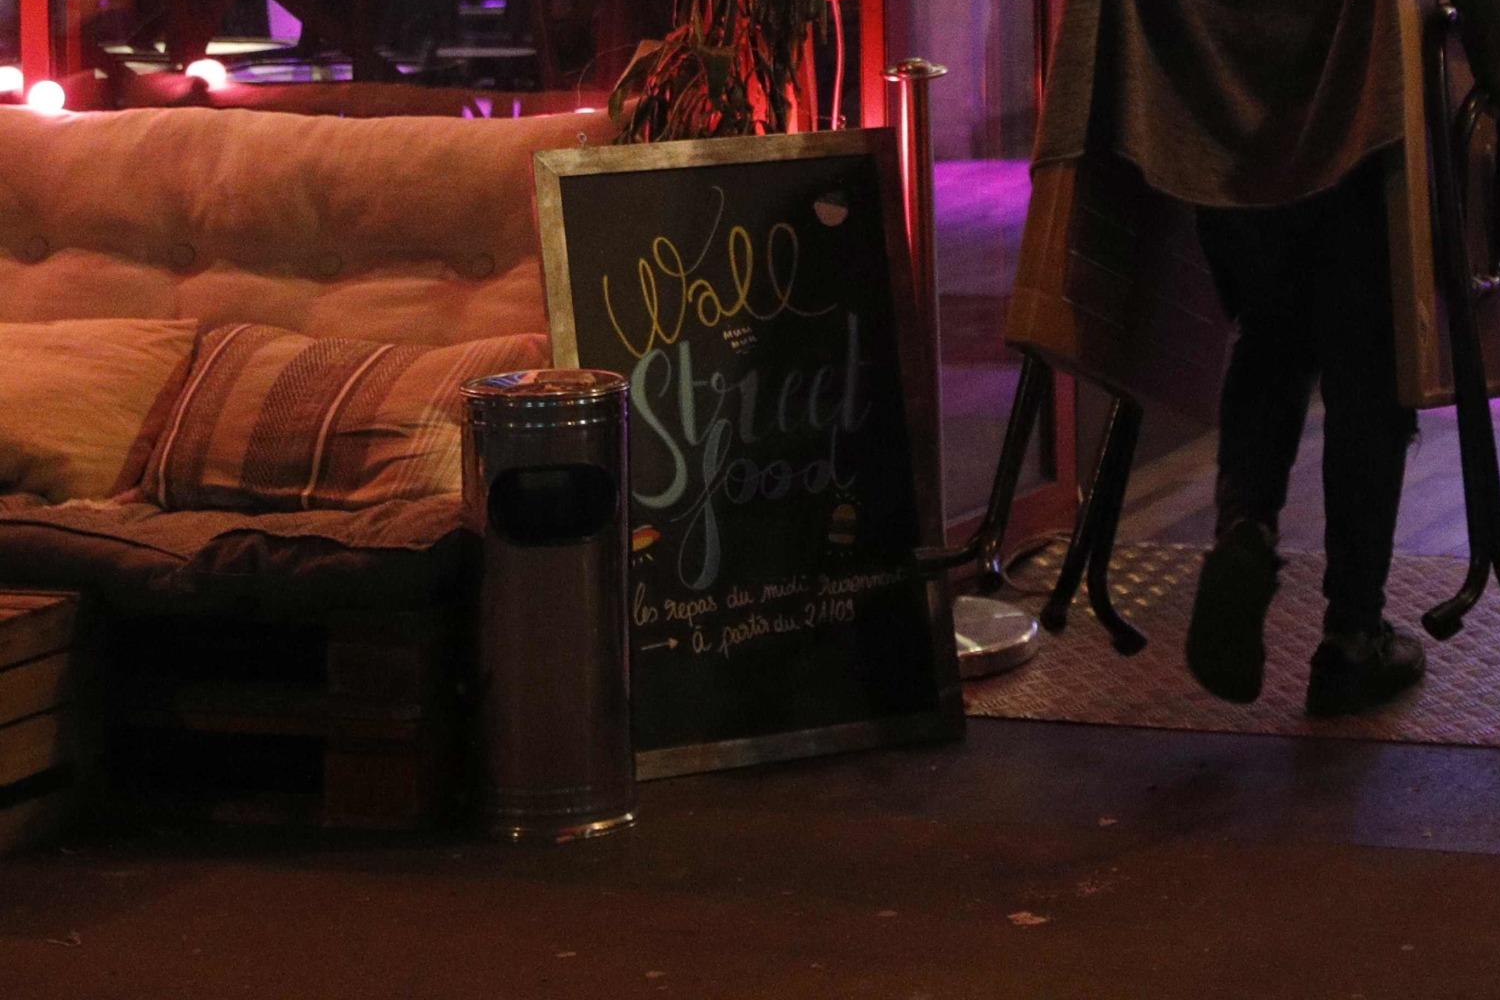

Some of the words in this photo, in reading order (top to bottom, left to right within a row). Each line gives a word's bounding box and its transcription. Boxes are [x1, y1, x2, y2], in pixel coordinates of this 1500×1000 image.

[603, 185, 838, 358] Wall
[631, 312, 873, 509] Street
[670, 418, 860, 591] food
[663, 595, 718, 628] repas
[726, 584, 756, 609] du
[760, 574, 811, 604] midi
[691, 624, 713, 653] à
[716, 612, 770, 660] partir
[773, 612, 801, 634] du
